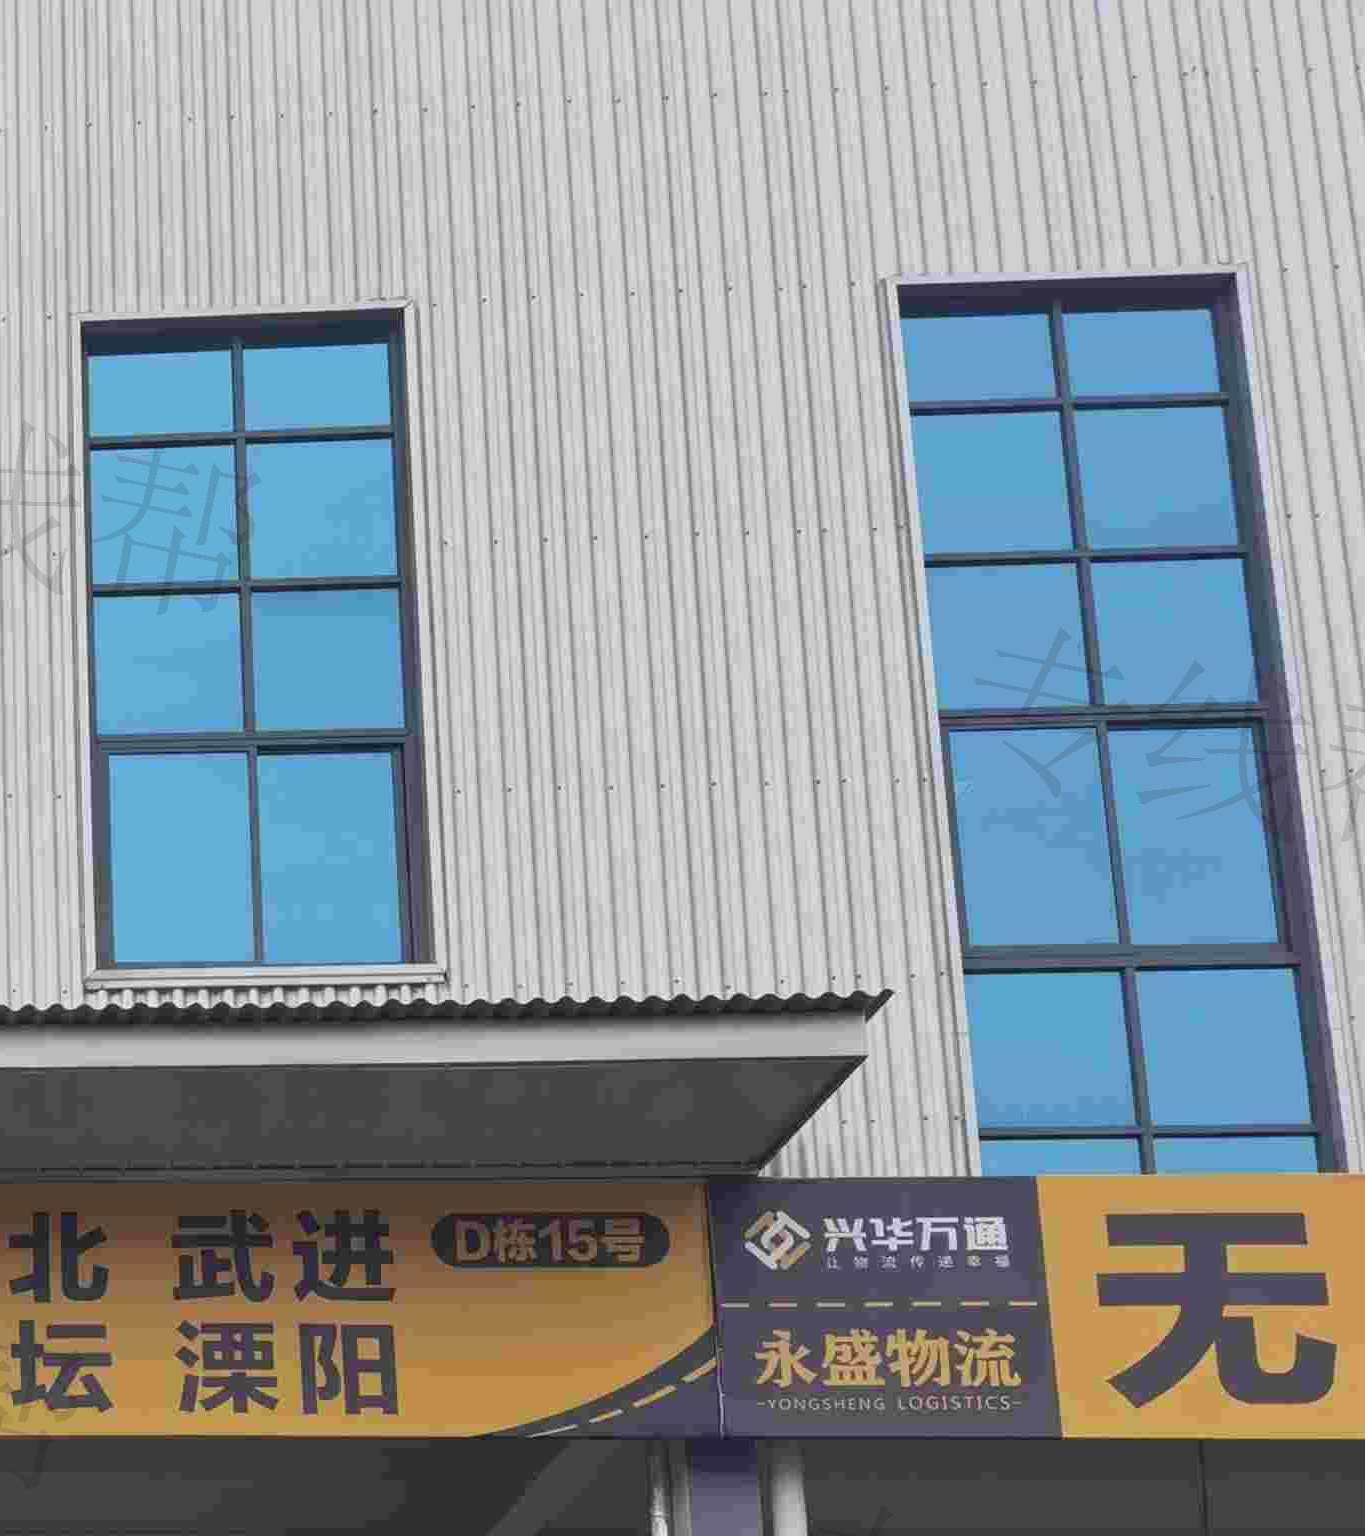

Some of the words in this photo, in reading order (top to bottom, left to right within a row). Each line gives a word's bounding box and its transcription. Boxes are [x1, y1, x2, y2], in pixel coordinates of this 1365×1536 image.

[171, 1208, 397, 1304] 武进
[454, 1217, 646, 1266] D栋15号
[822, 1216, 1009, 1251] 兴华万通
[1096, 1212, 1338, 1409] 无
[173, 1320, 400, 1415] 溧阳
[755, 1329, 1022, 1388] 永盛物流
[767, 1396, 886, 1411] YONGSHENG
[897, 1396, 1013, 1411] LOGISTICS
